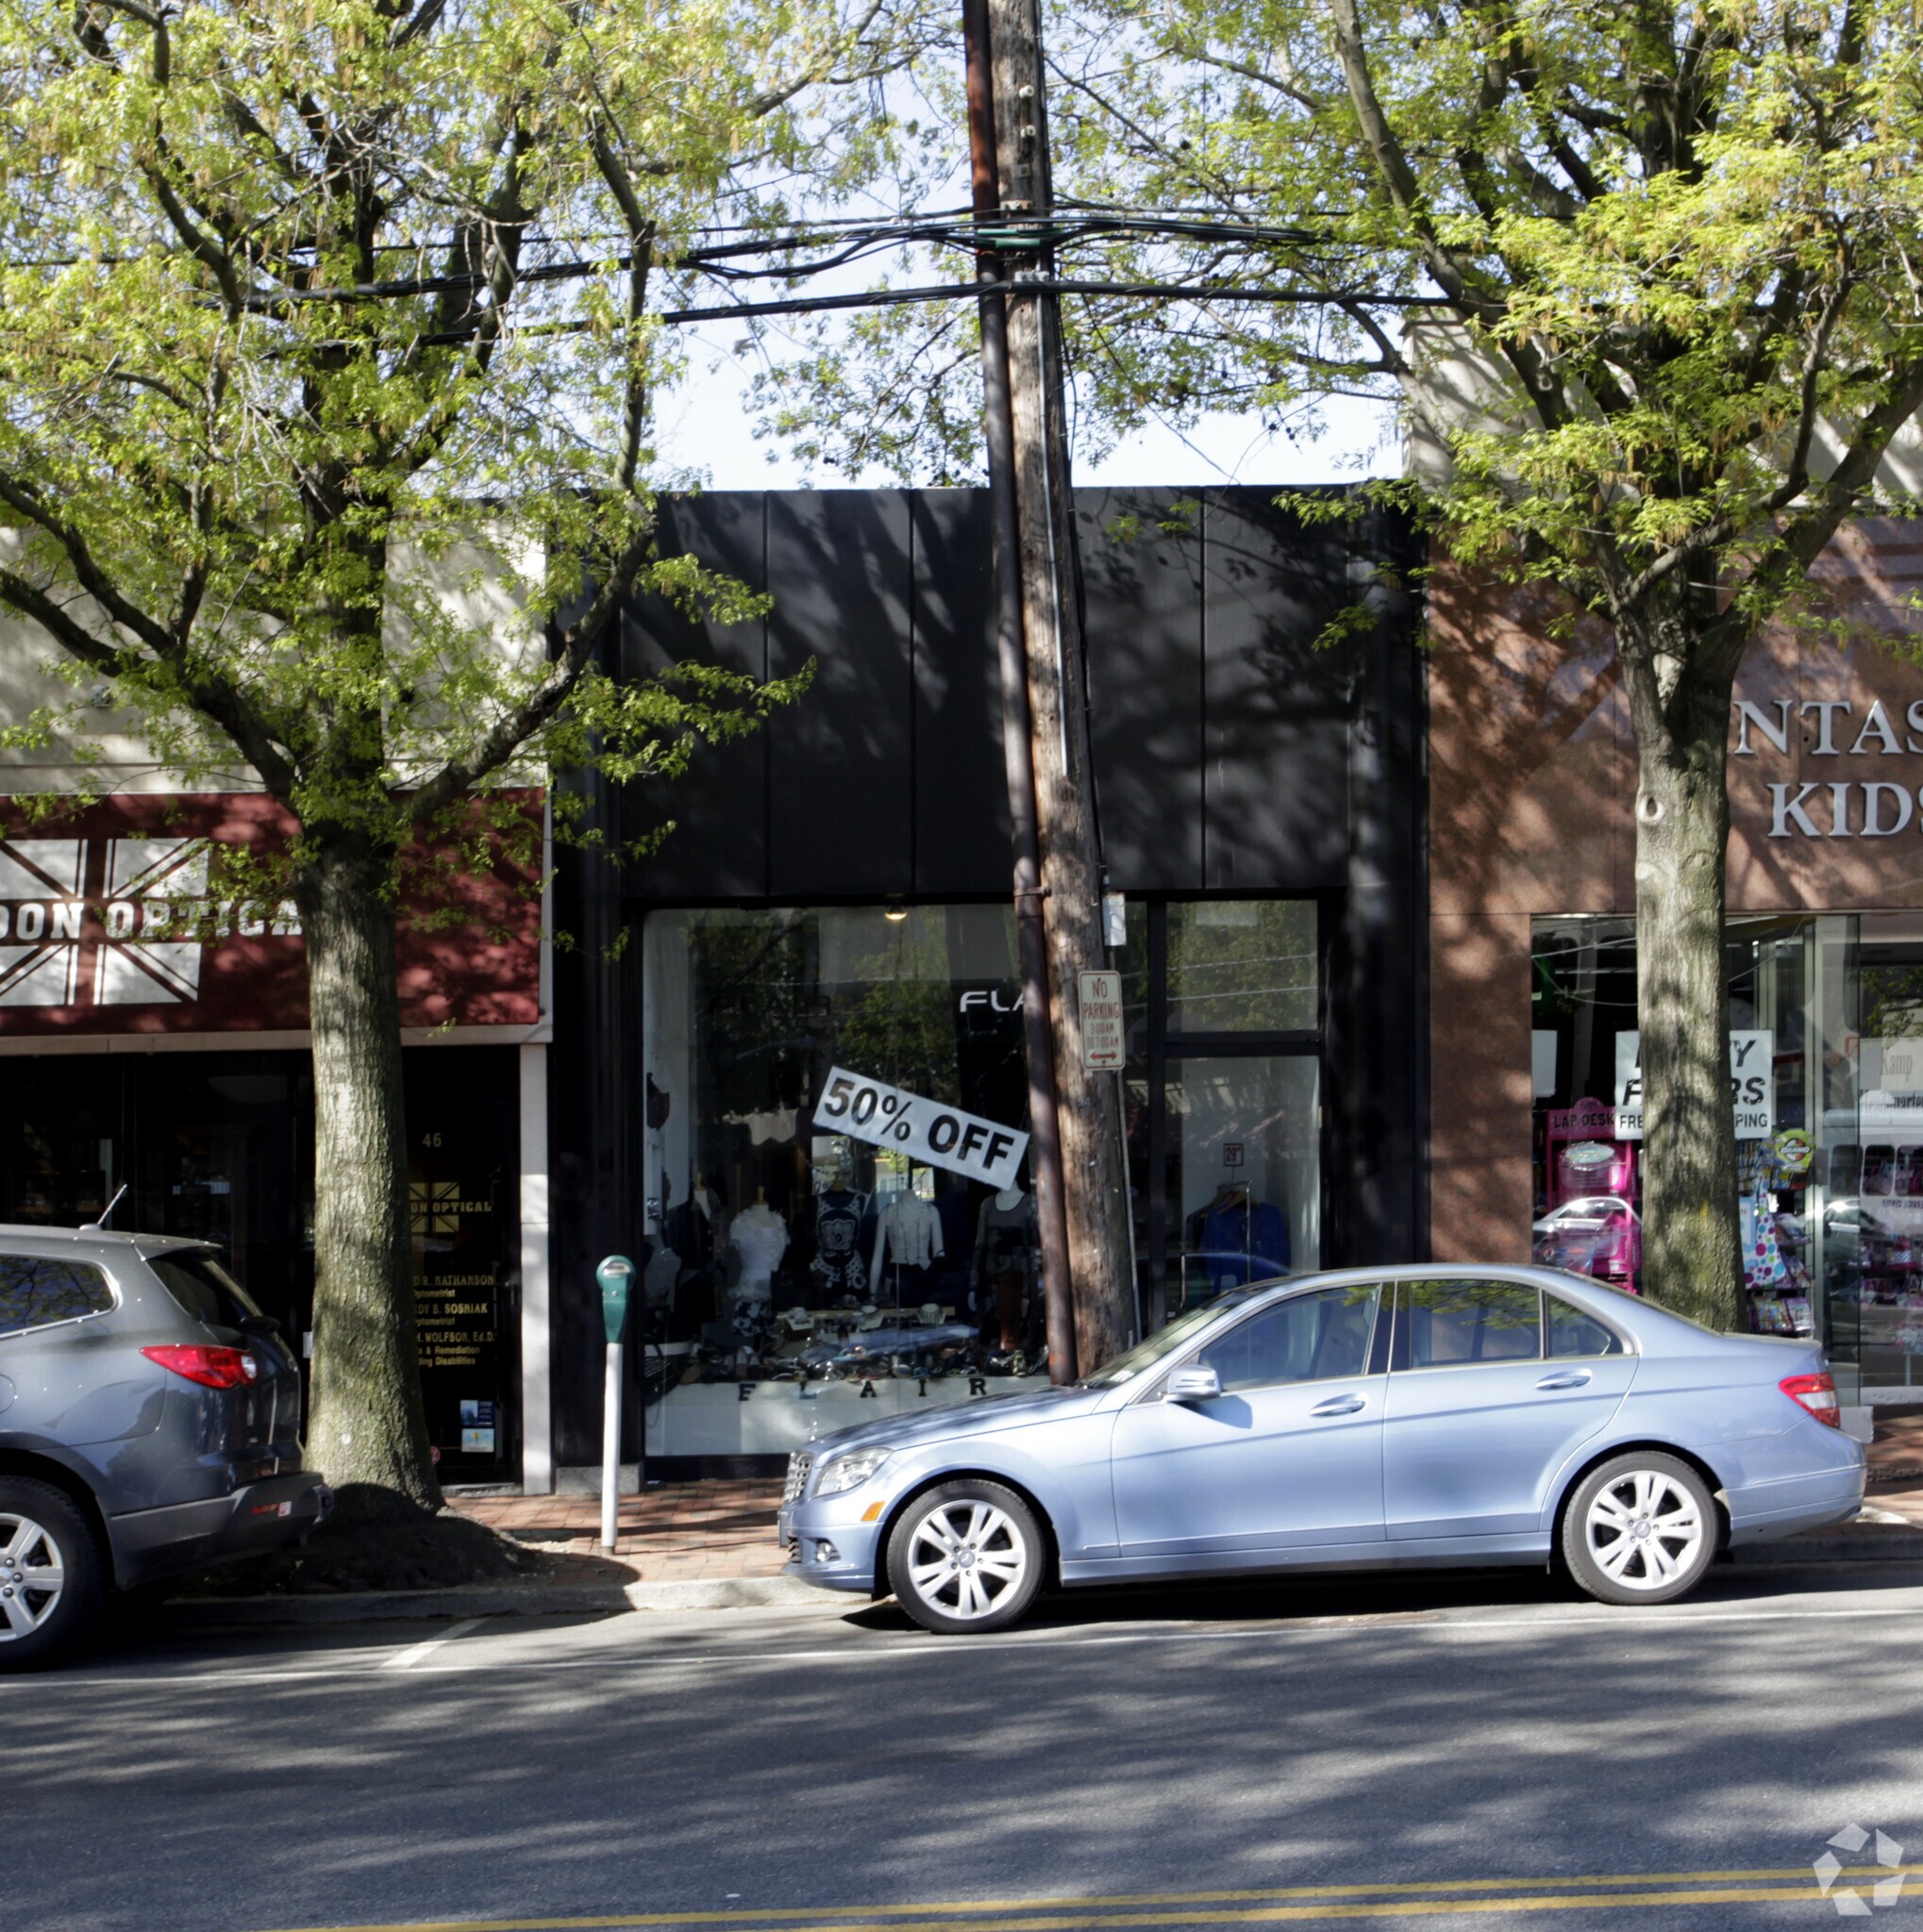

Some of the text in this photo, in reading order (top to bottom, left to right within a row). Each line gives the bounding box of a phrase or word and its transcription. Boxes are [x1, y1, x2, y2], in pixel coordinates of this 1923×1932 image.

[1734, 699, 1923, 756] NTAS
[1768, 782, 1923, 838] KID
[107, 900, 303, 938] OPTICA
[1093, 981, 1108, 998] NO
[959, 991, 1024, 1012] FLA
[1083, 1002, 1120, 1019] PARKING
[824, 1077, 1015, 1170] 50% OFF
[1553, 1114, 1578, 1128] LAP
[423, 1132, 442, 1148] 46
[432, 1201, 493, 1213] OPTICAL
[443, 1302, 489, 1314] SOSNIAK
